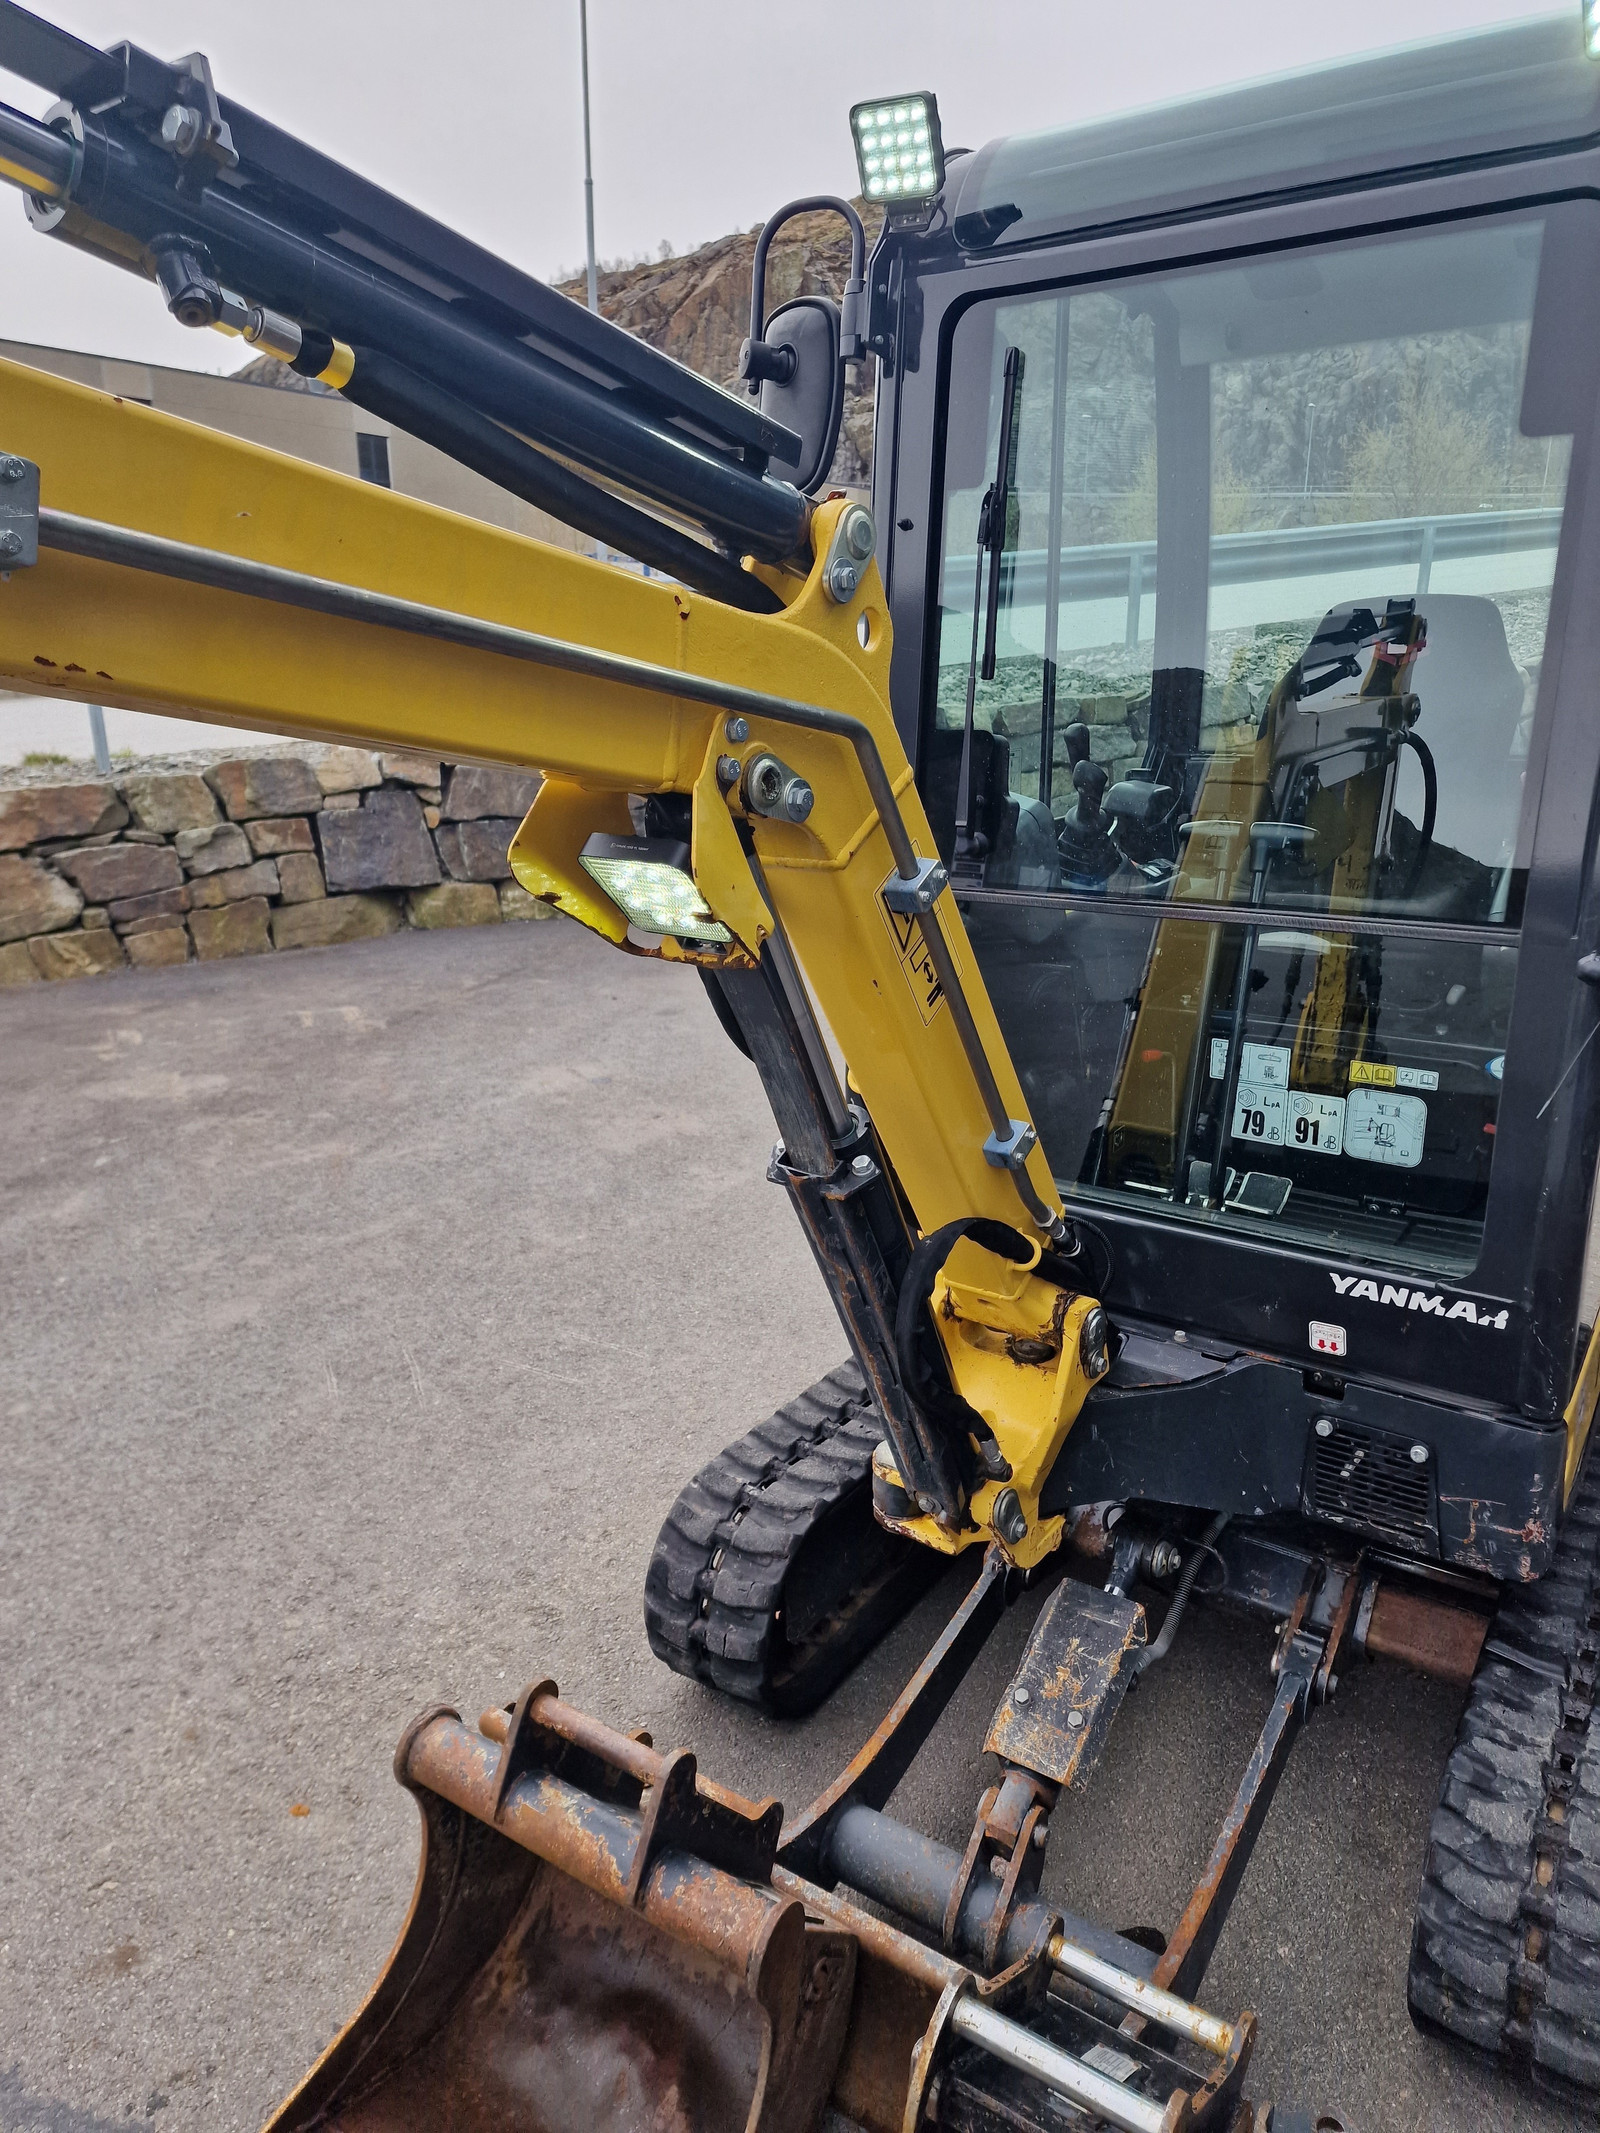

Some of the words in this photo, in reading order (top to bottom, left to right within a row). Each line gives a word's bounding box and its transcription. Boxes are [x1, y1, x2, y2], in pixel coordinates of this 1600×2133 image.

[1241, 1108, 1265, 1137] 79
[1266, 1126, 1280, 1141] dB
[1295, 1116, 1320, 1146] 91
[1323, 1135, 1337, 1150] dB
